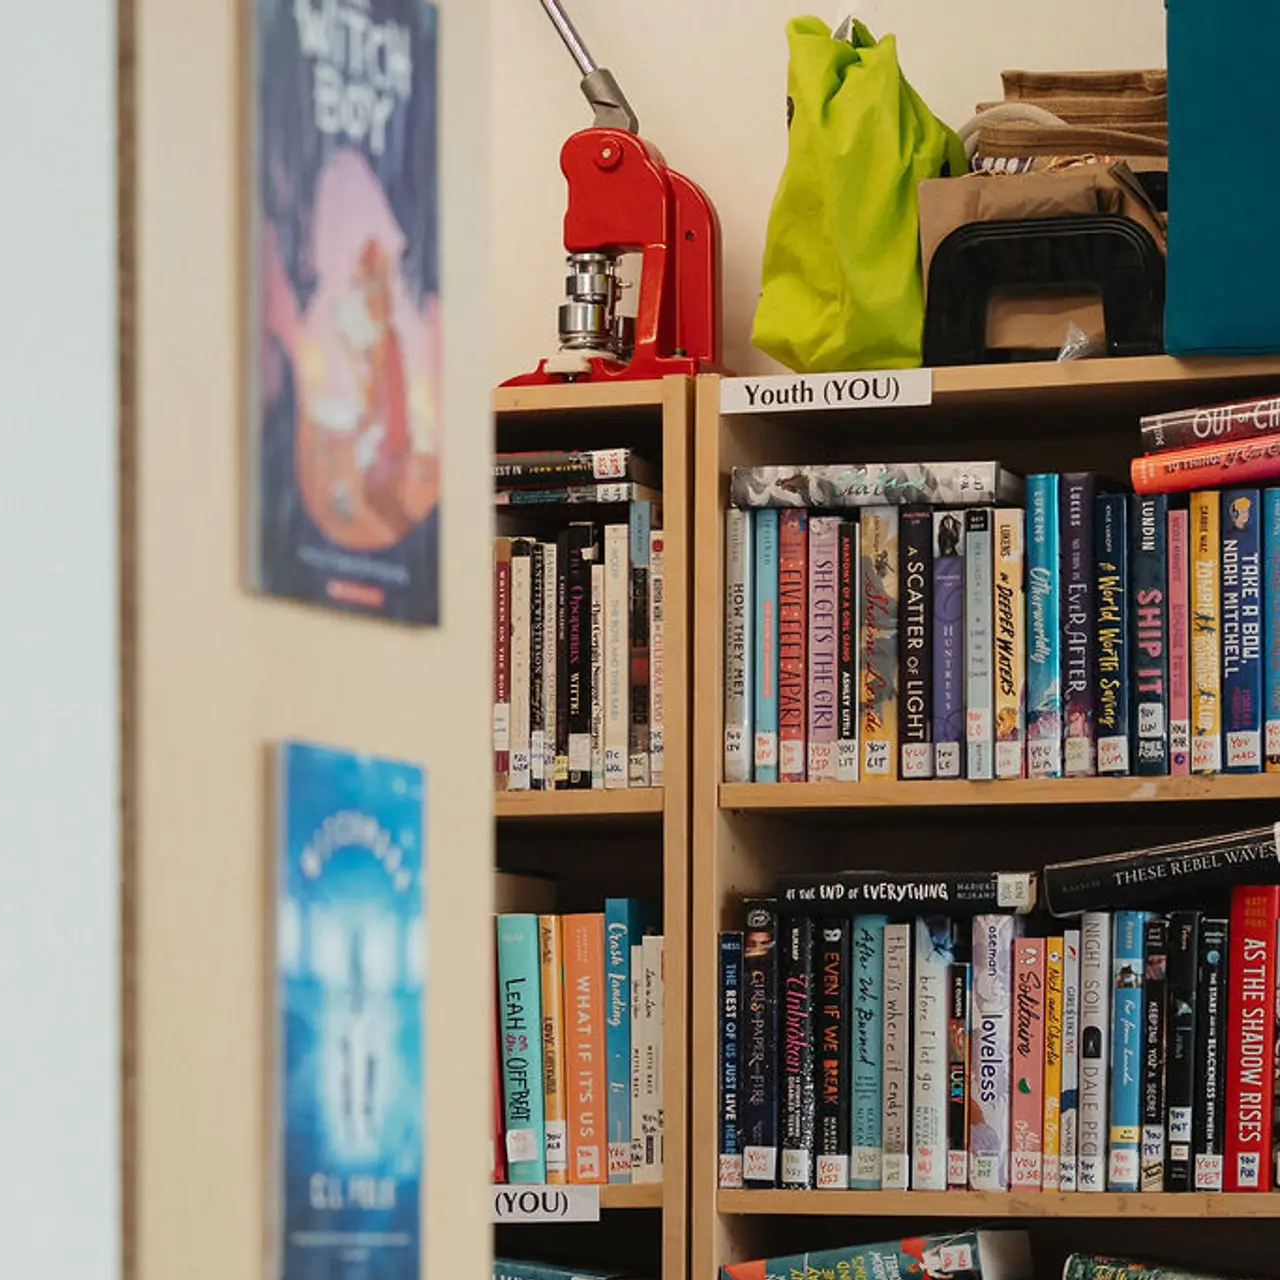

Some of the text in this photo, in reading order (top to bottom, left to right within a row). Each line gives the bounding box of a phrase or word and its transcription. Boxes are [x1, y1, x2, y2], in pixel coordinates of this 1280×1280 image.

[312, 60, 395, 157] BOY
[744, 377, 900, 406] Youth (YOU)
[1192, 407, 1232, 438] OUT
[780, 568, 802, 731] FIVE FEET APART
[812, 559, 834, 734] SHE GETS THE GIRL
[906, 545, 924, 740] A SCATTER OF LIGHT
[1138, 500, 1162, 695] LUNDIN SHIP IT
[1224, 539, 1238, 679] NOAH MITCHELL
[608, 921, 628, 1028] Crash Landing
[726, 963, 736, 1120] THE REST OF US JUST LIVE
[824, 952, 840, 1104] EVEN IF WE BREAK
[980, 925, 1004, 1103] oseman loveless
[1016, 971, 1041, 1058] Solitaire
[1066, 1016, 1076, 1038] LIKE
[1084, 920, 1100, 1111] NIGHT SOIL DALE
[1238, 937, 1266, 1142] AS THE SHADOW RISES
[576, 975, 594, 1138] WHAT IF IT'S US
[495, 1191, 569, 1216] (YOU)
